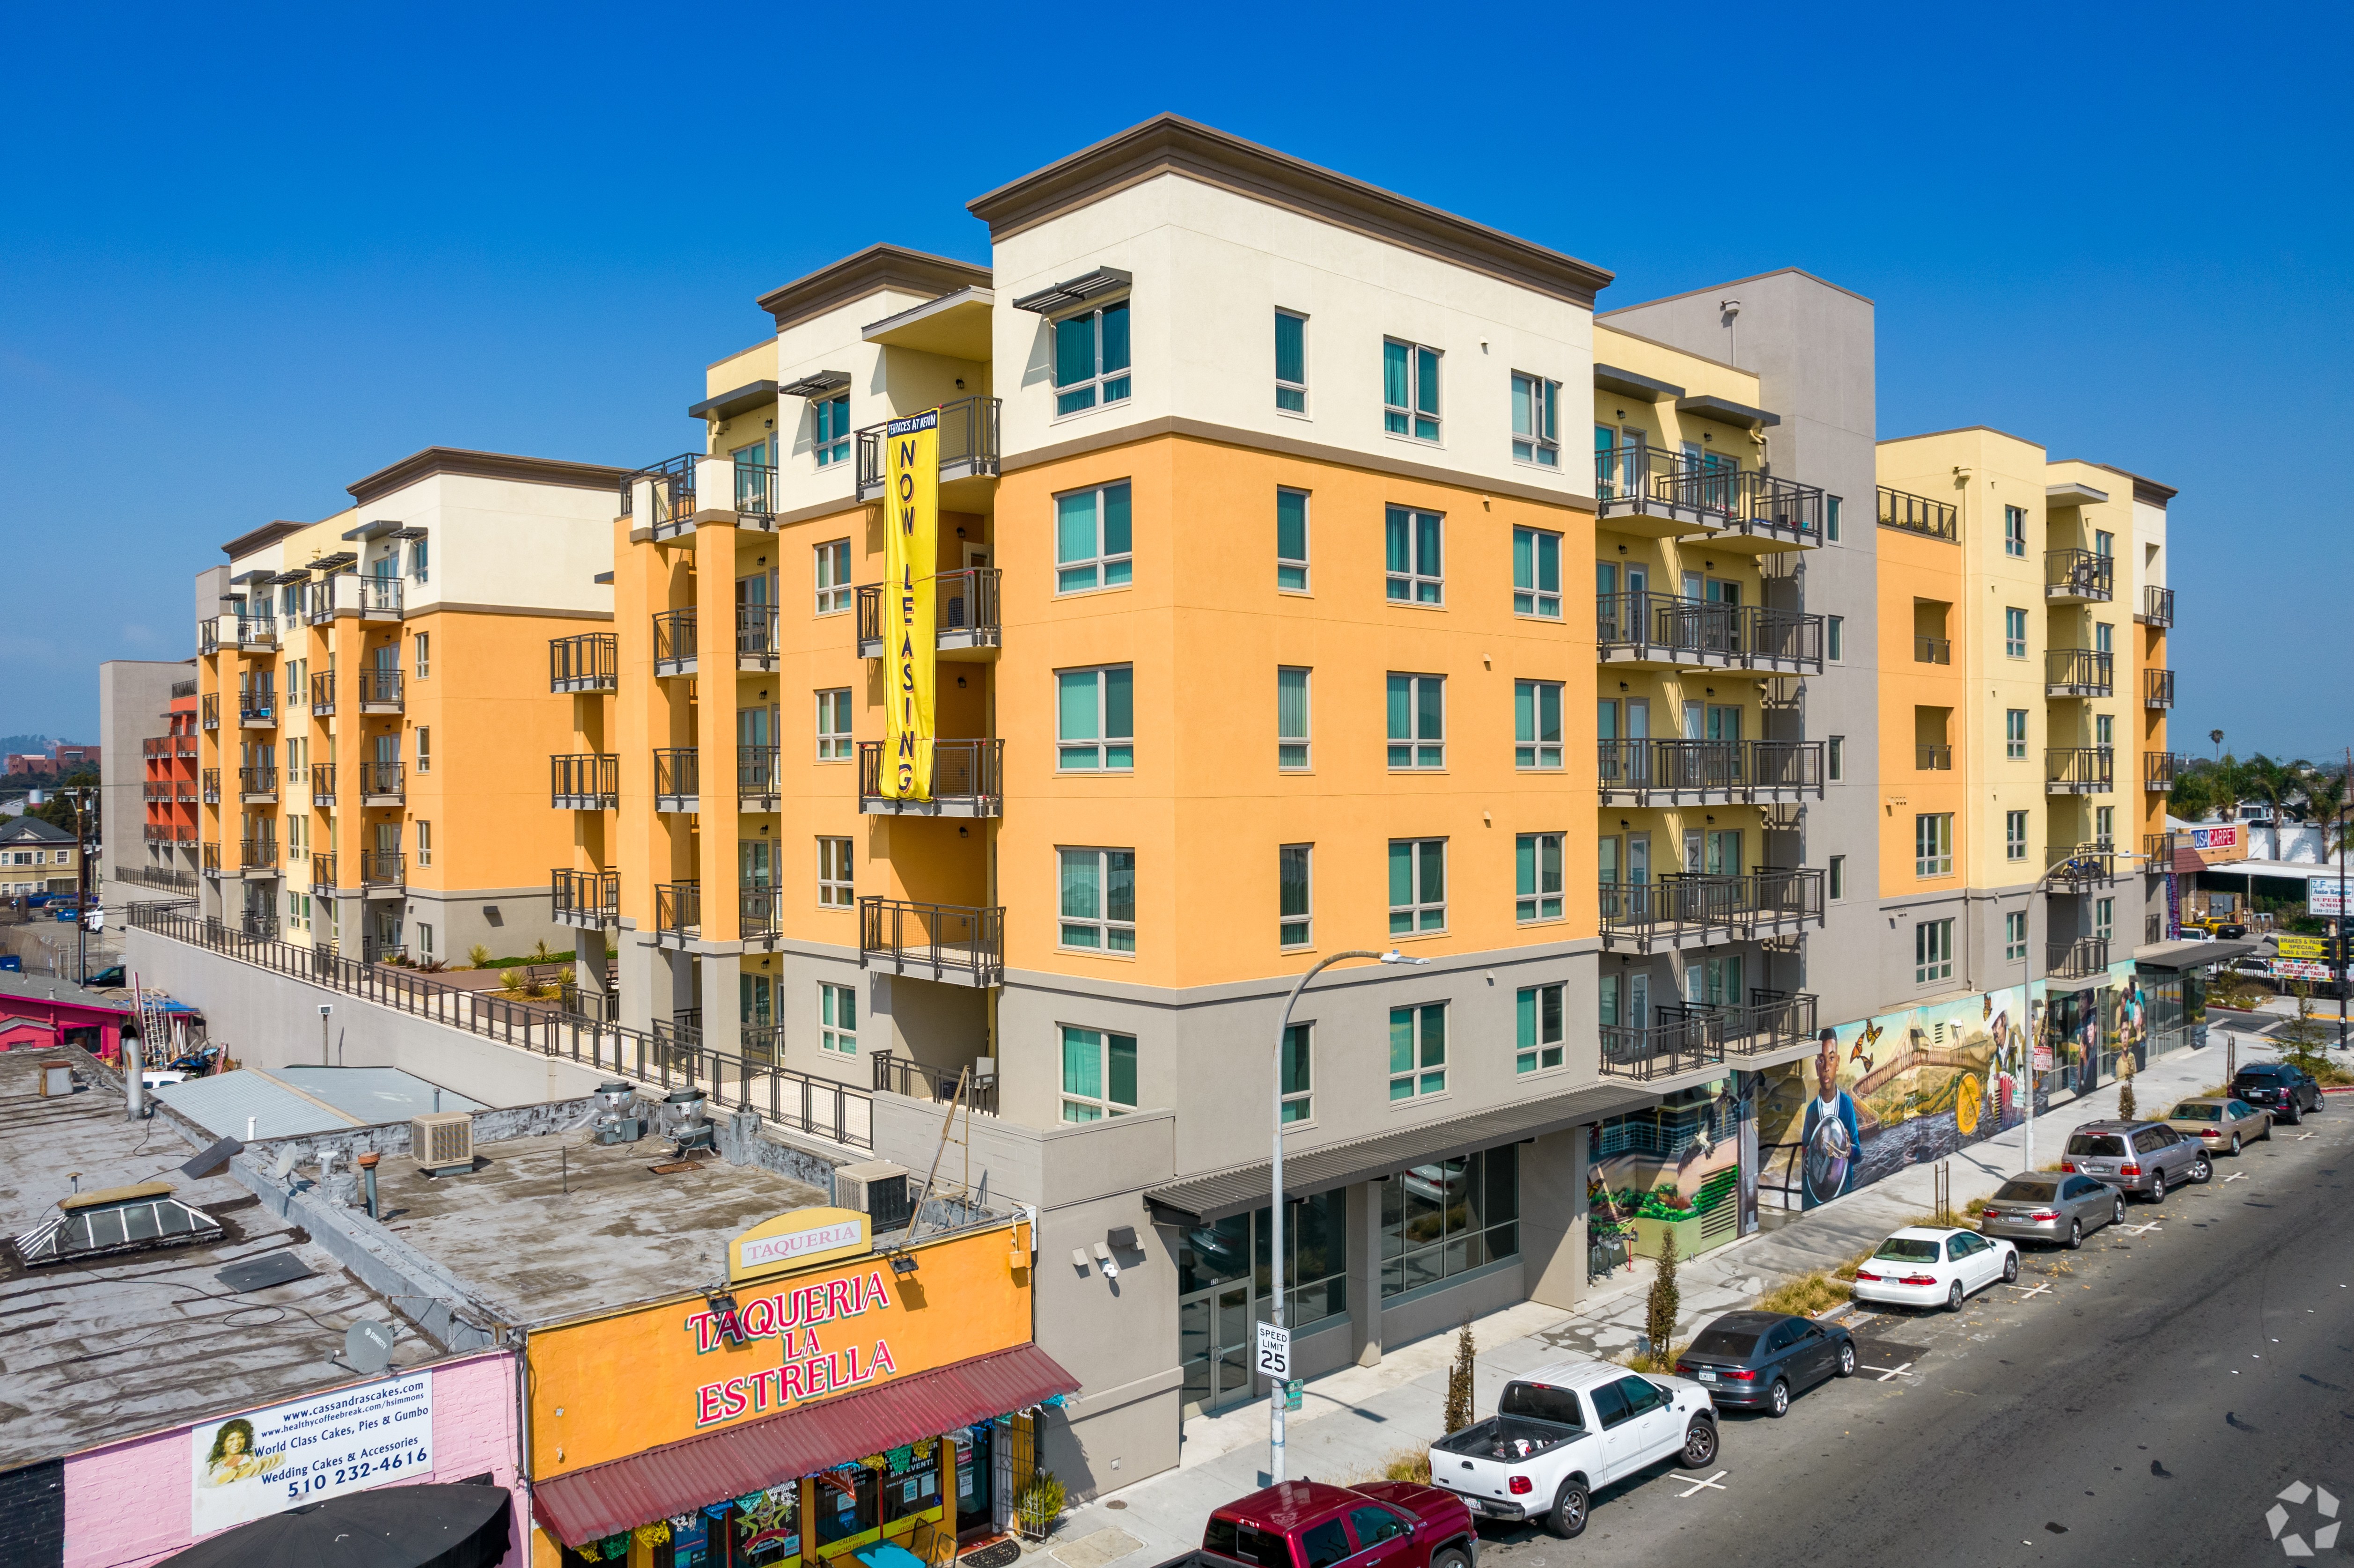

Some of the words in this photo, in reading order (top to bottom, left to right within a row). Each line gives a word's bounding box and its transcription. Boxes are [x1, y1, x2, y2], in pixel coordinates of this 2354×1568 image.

[888, 420, 911, 435] TERRACES
[912, 418, 920, 430] AT
[900, 440, 916, 537] NOW
[898, 563, 915, 794] LEASING
[2195, 831, 2208, 847] USA
[2209, 828, 2236, 846] CARPET
[748, 1226, 856, 1260] TAQUERIA
[685, 1271, 890, 1352] TAQUERIA
[783, 1326, 822, 1362] LA
[1260, 1328, 1287, 1342] SPEED
[1263, 1339, 1284, 1352] LIMIT
[1261, 1350, 1286, 1373] 25
[696, 1339, 897, 1427] ESTRELLA
[261, 1393, 424, 1437] www.healthycoffeebreak.com/hsimmons
[283, 1382, 424, 1421] www.cassandrascakes.com
[255, 1440, 286, 1457] World
[291, 1435, 317, 1448] Class
[321, 1427, 354, 1441] Cakes,
[359, 1420, 378, 1431] Pies
[383, 1415, 390, 1425] &
[395, 1406, 428, 1421] Gumbo
[261, 1466, 308, 1485] Wedding
[312, 1457, 343, 1471] Cakes
[347, 1452, 356, 1462] &
[360, 1436, 418, 1458] Accessories
[906, 1458, 933, 1473] EVENT!
[912, 1451, 932, 1462] NET
[288, 1474, 326, 1497] 510
[335, 1447, 427, 1485] 232-4616
[899, 1523, 915, 1532] VEGGI
[912, 1512, 926, 1521] FOOD
[832, 1545, 852, 1556] NACHO
[853, 1539, 866, 1549] FRIES
[839, 1535, 860, 1546] CALDOS
